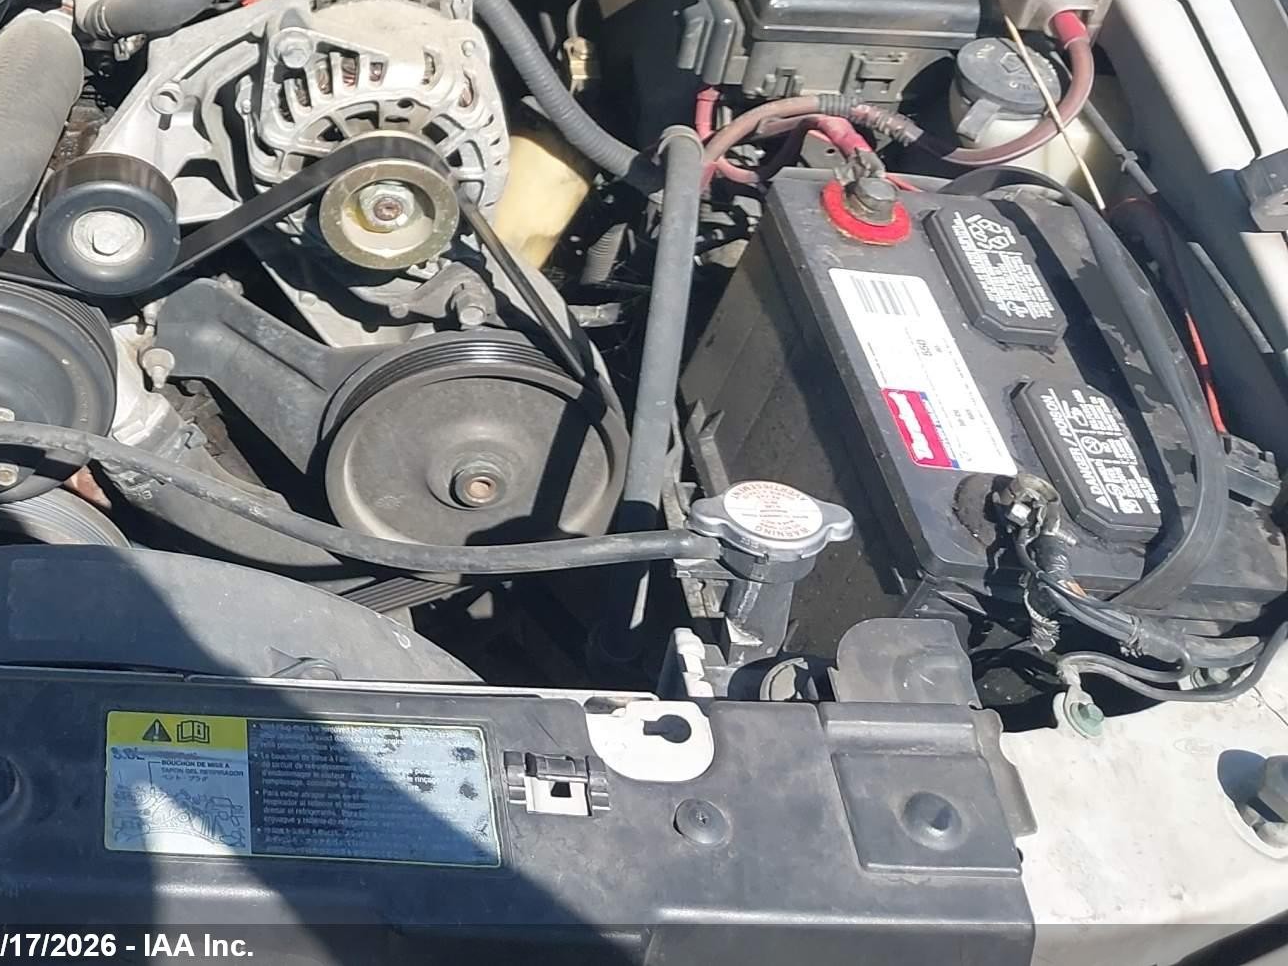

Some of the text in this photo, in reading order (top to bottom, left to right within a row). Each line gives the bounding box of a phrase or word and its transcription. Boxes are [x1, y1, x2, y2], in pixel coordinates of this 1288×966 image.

[1040, 395, 1073, 437] POISON
[1068, 447, 1105, 496] DANGER
[197, 760, 207, 768] DE
